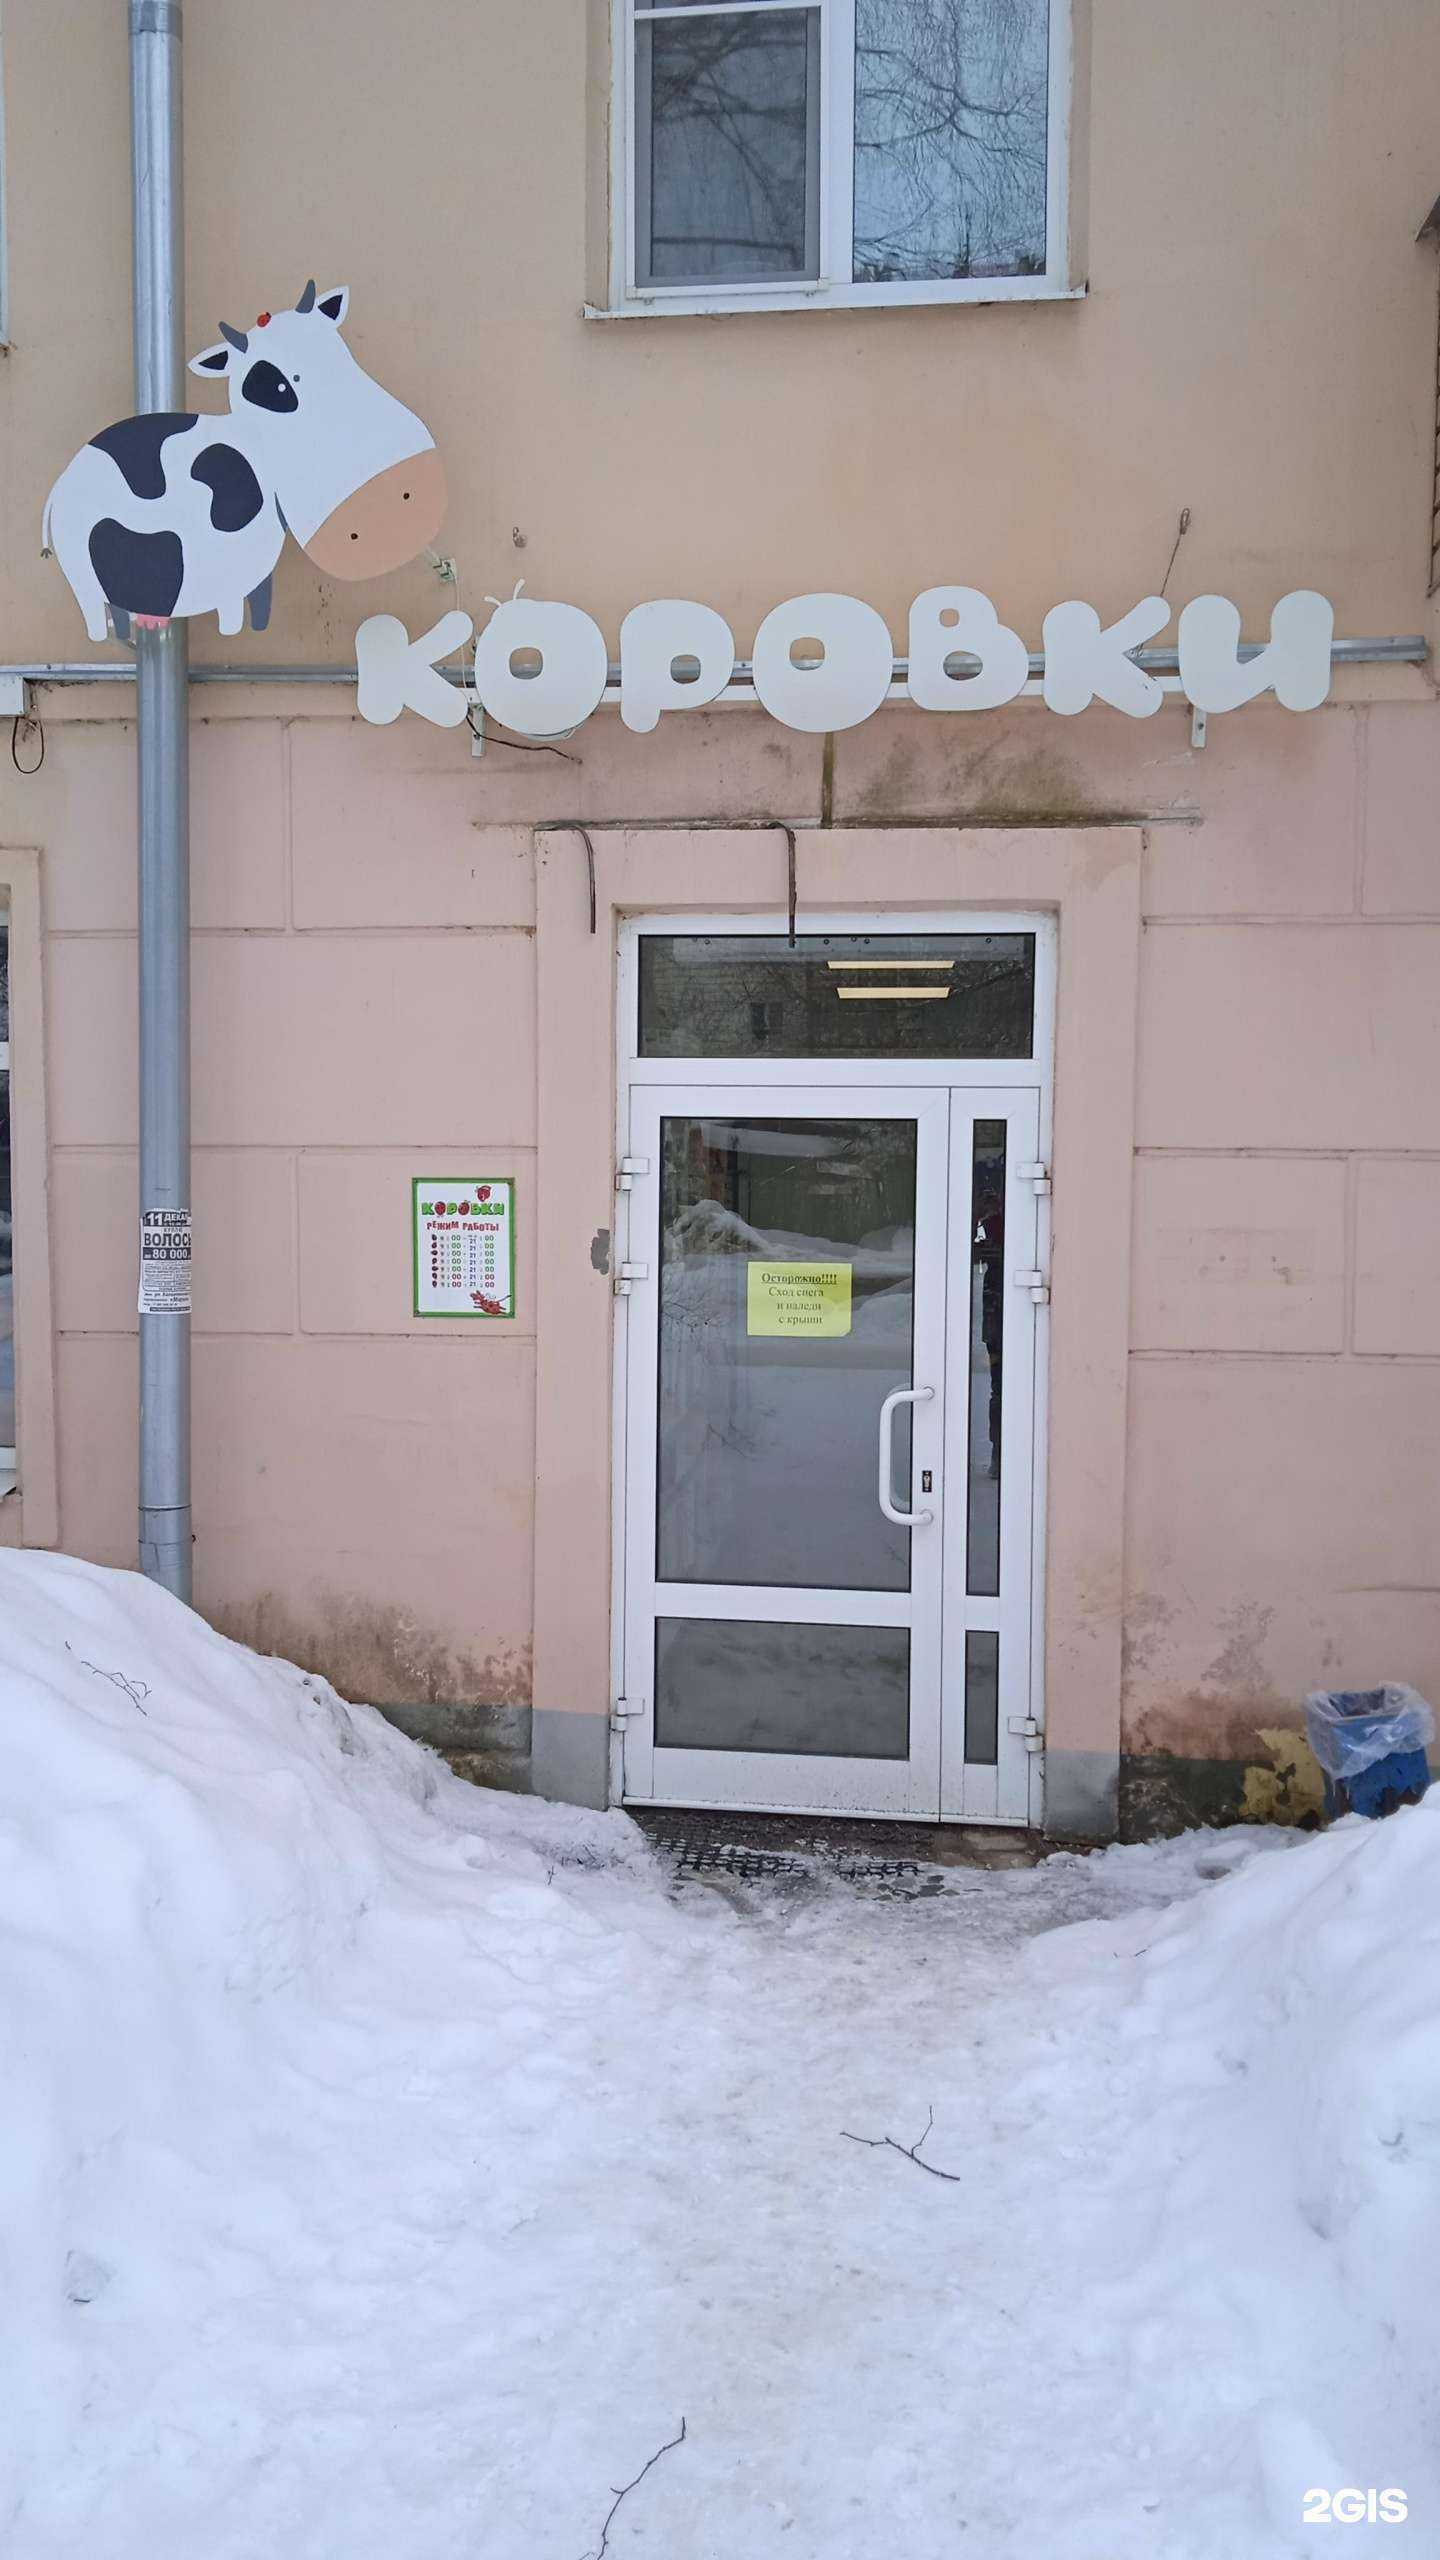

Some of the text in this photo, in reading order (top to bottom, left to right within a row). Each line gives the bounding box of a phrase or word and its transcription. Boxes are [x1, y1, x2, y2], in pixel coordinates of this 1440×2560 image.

[426, 1220, 499, 1231] РЕЖИМ РАБОТЫ
[152, 1248, 167, 1259] 80
[761, 1272, 837, 1285] Осторожно!!!!
[768, 1286, 824, 1297] Сход снега
[786, 1302, 822, 1311] наледи
[786, 1316, 823, 1326] крыши
